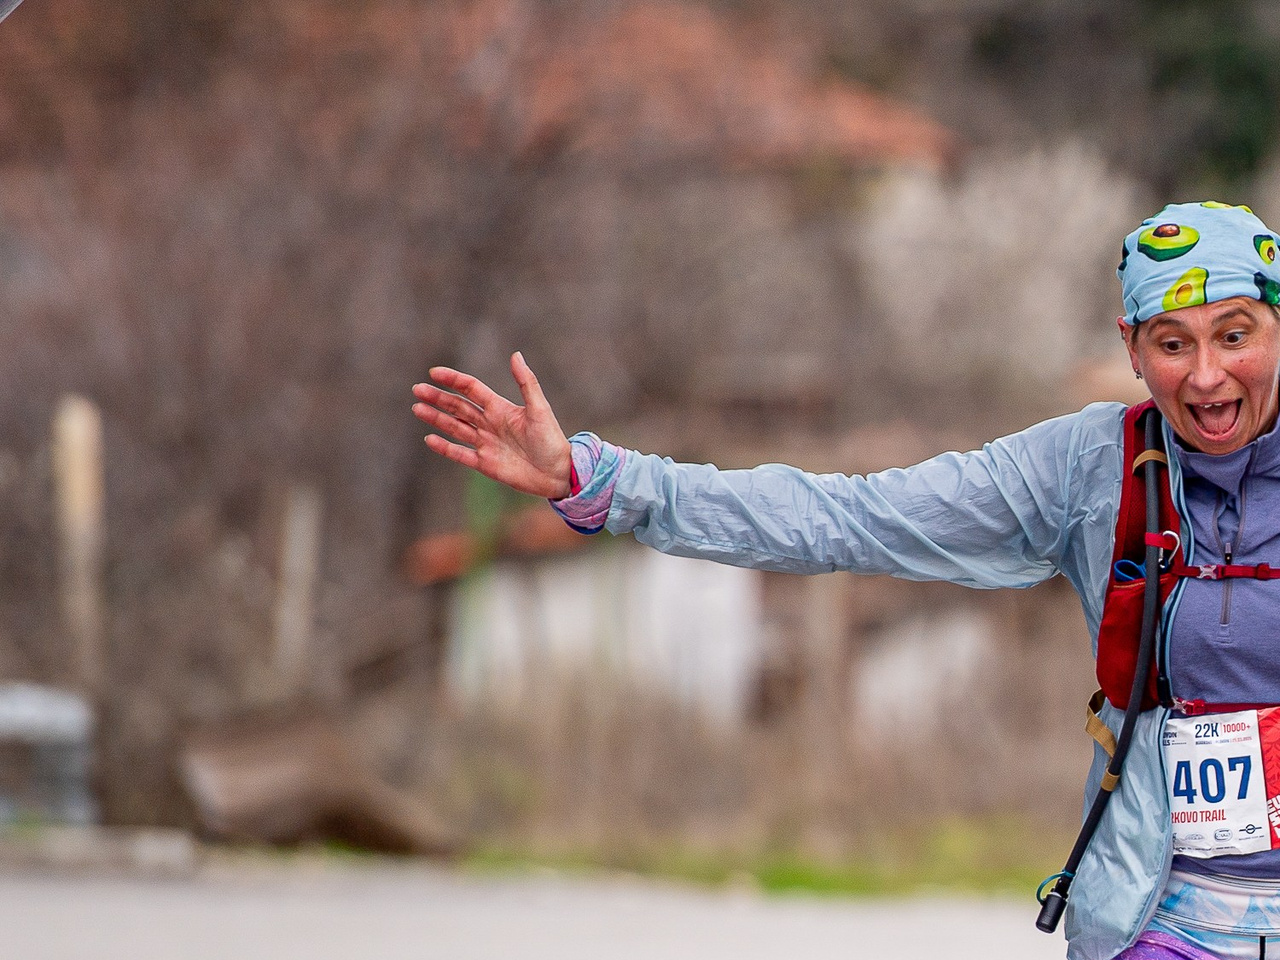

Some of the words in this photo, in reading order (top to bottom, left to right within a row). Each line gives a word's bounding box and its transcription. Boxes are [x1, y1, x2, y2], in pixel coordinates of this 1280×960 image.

[1195, 722, 1219, 738] 22K
[1173, 755, 1252, 804] 407
[1171, 811, 1198, 824] RKOVO
[1200, 809, 1227, 822] TRAIL
